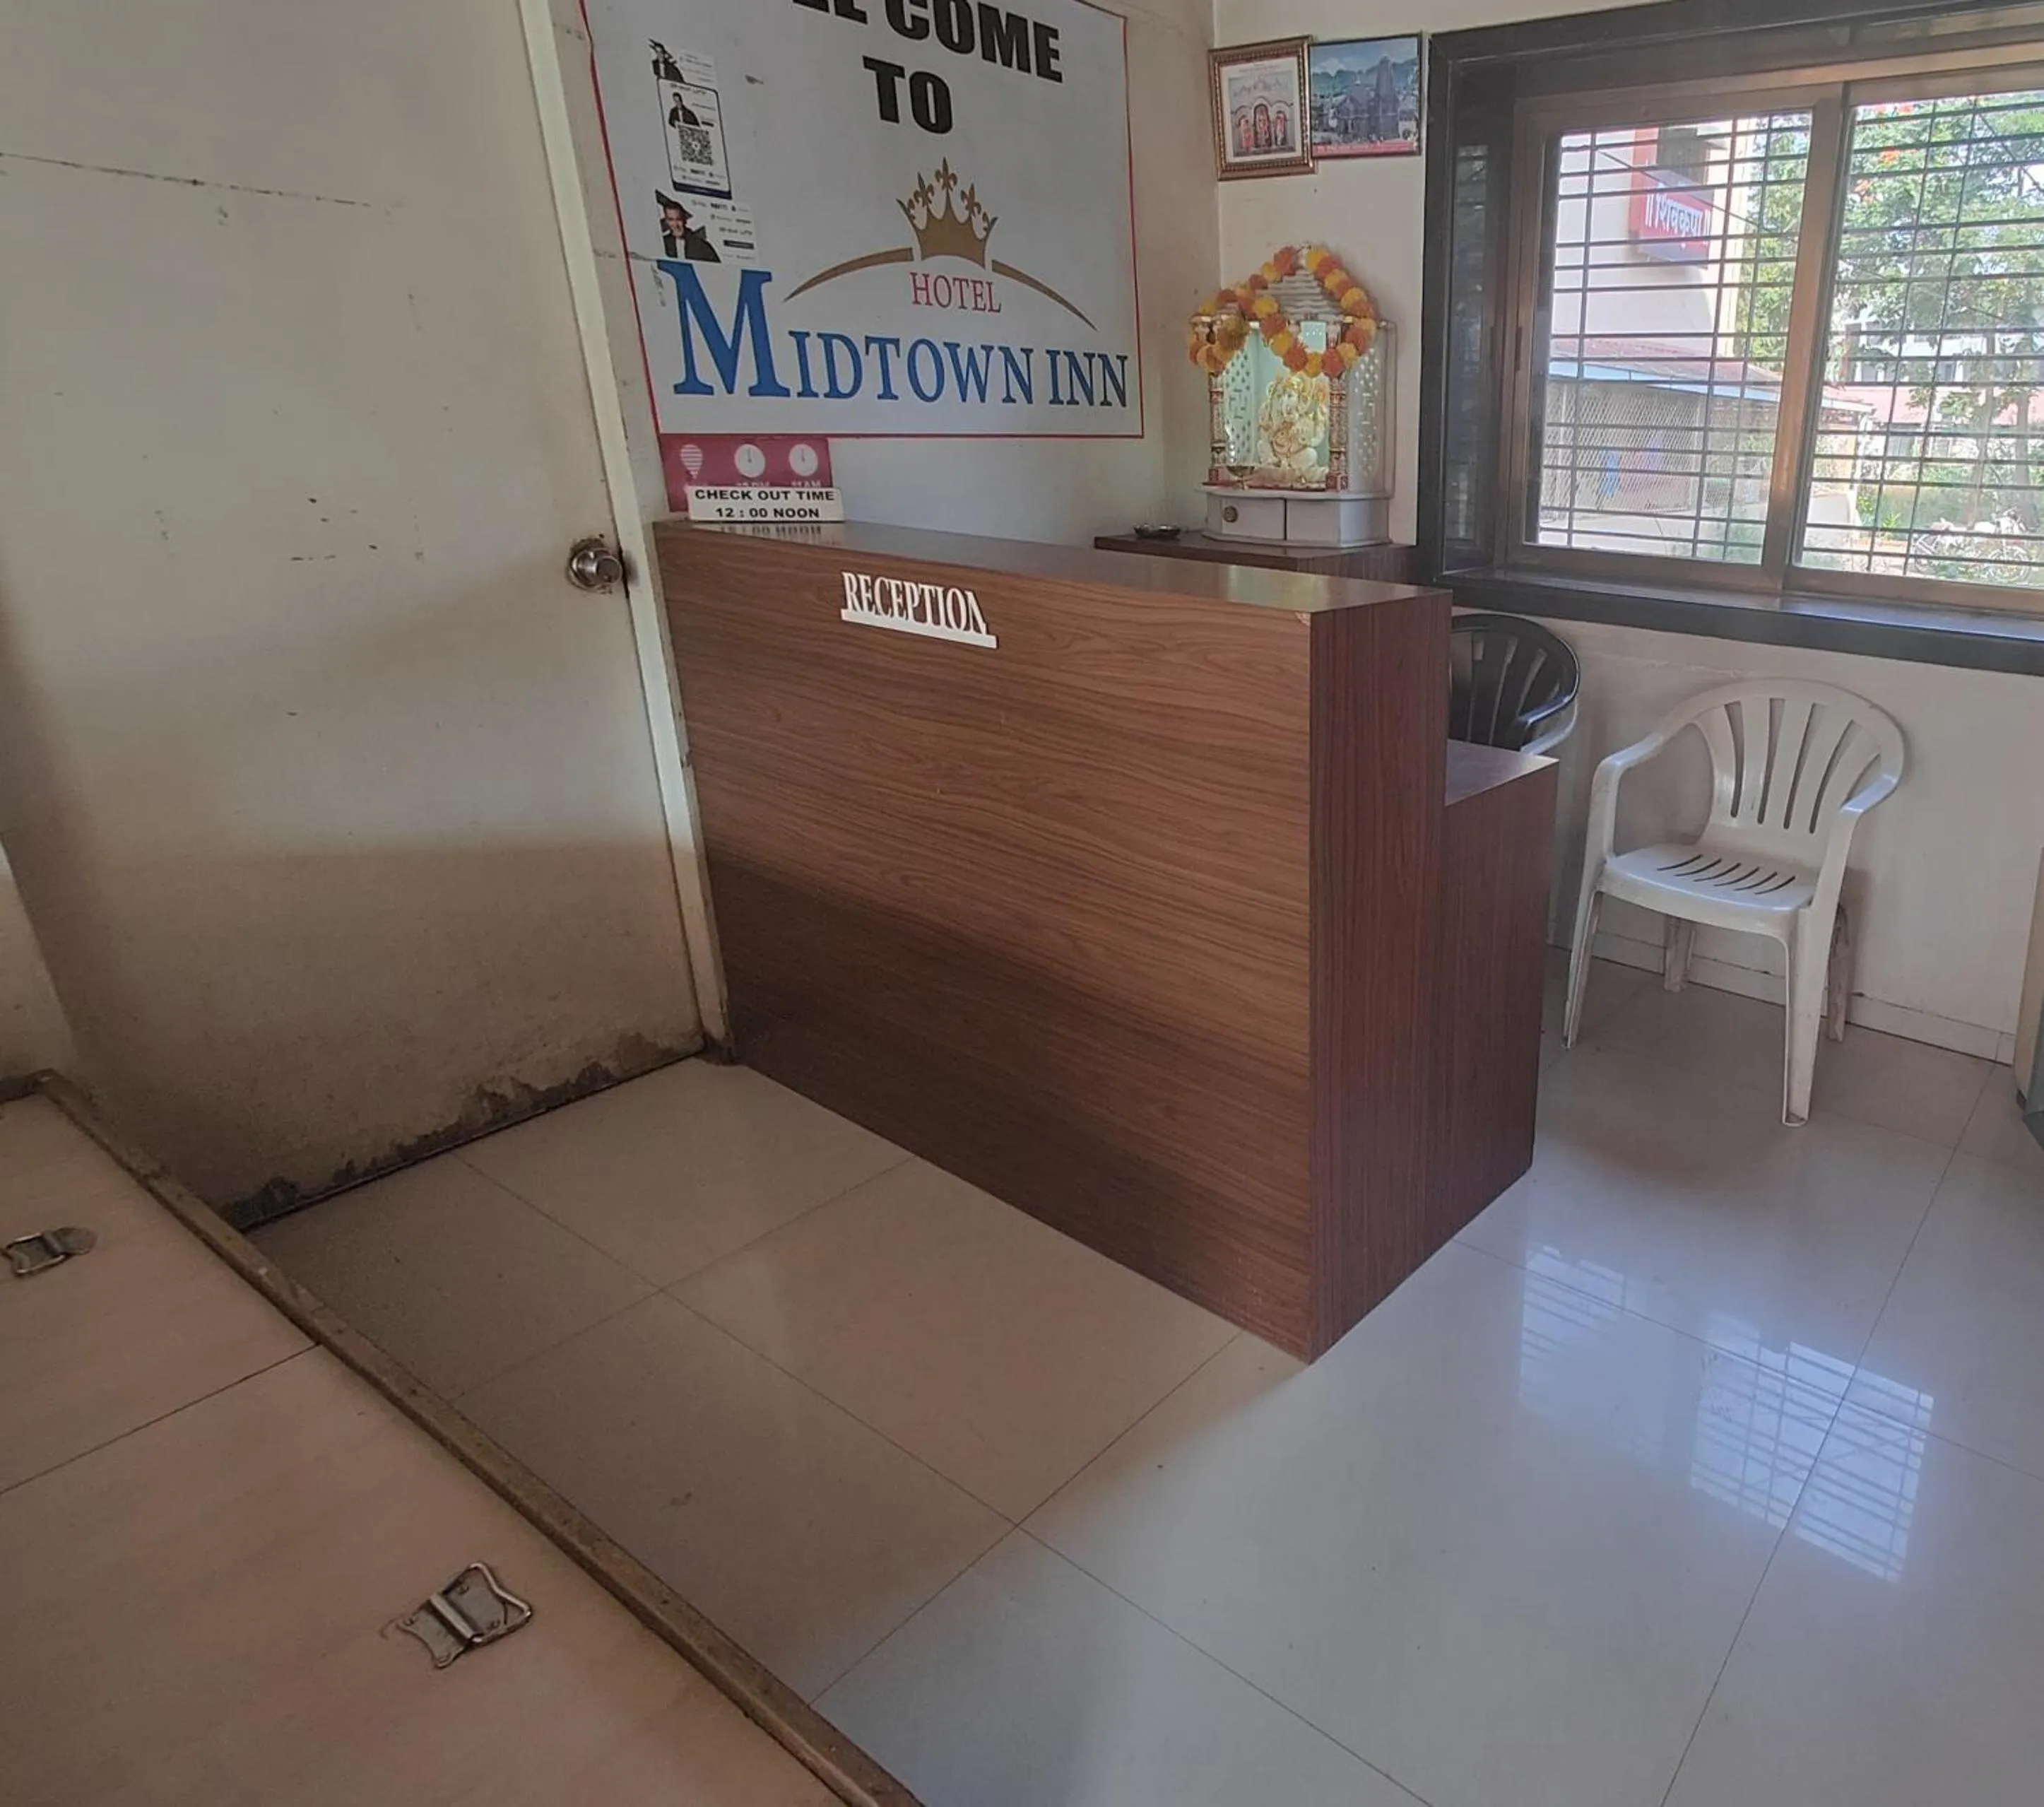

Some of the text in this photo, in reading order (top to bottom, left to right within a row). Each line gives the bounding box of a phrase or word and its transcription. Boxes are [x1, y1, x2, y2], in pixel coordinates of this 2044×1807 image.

[863, 56, 953, 134] TO
[909, 271, 1003, 314] HOTEL
[656, 259, 1128, 408] MIDTOWN INN
[695, 489, 835, 501] CHECK OUT TIME
[716, 508, 733, 518] 12
[749, 508, 768, 518] 00
[774, 508, 820, 518] NOON
